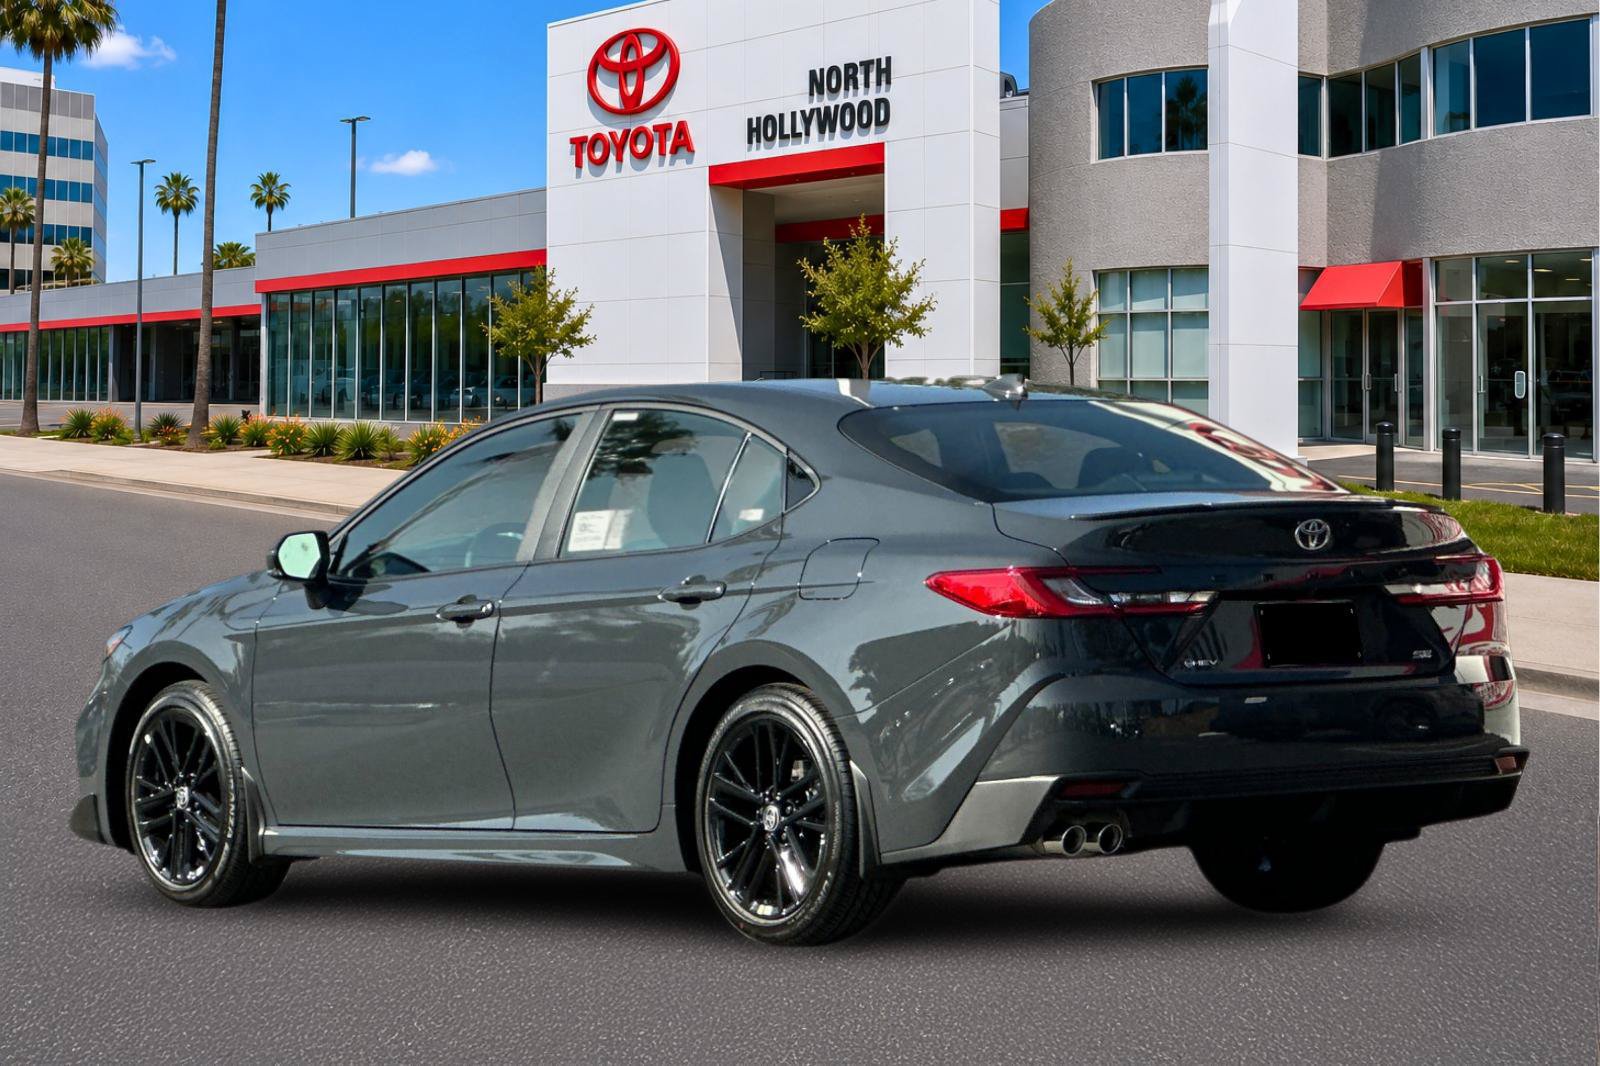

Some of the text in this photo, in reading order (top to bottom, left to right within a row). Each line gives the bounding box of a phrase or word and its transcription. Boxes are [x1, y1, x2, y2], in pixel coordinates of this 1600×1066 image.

[808, 56, 893, 97] NORTH
[569, 120, 696, 169] TOYOTA
[747, 97, 891, 145] HOLLYWOOD
